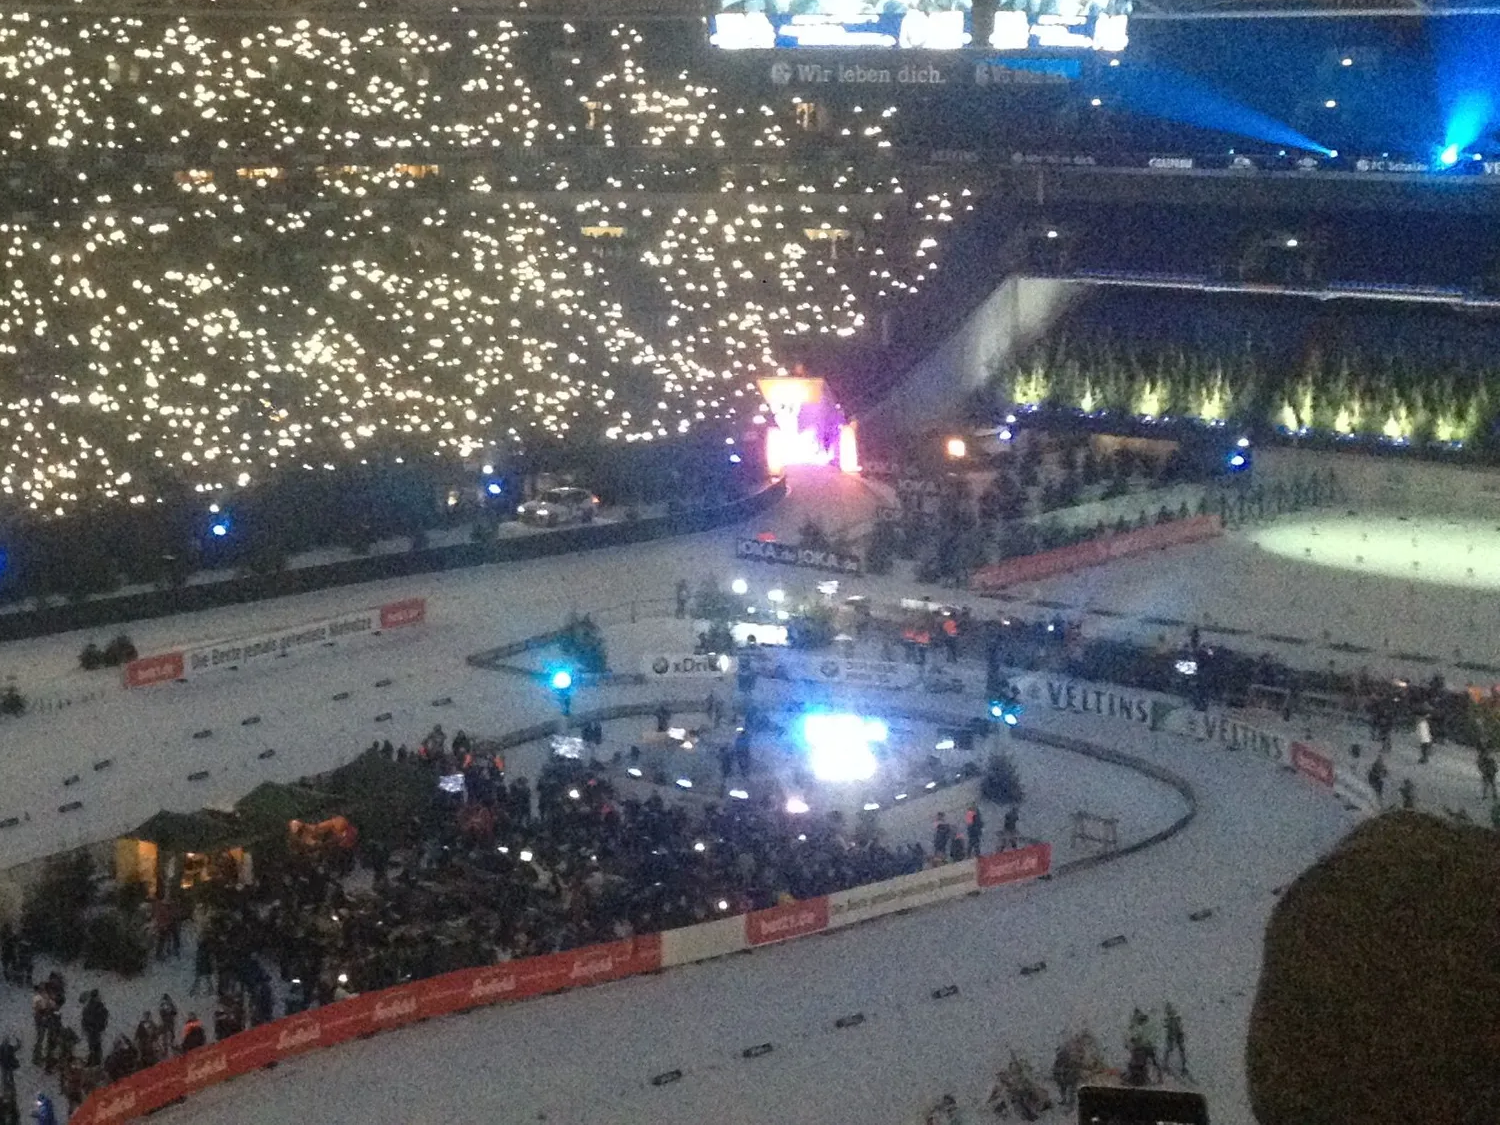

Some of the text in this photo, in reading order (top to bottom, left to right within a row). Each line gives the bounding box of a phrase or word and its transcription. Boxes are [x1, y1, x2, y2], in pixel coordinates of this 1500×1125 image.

[797, 62, 946, 85] Wir leben dich.
[1048, 680, 1149, 723] VELTINS
[1204, 711, 1283, 760] VELTINS
